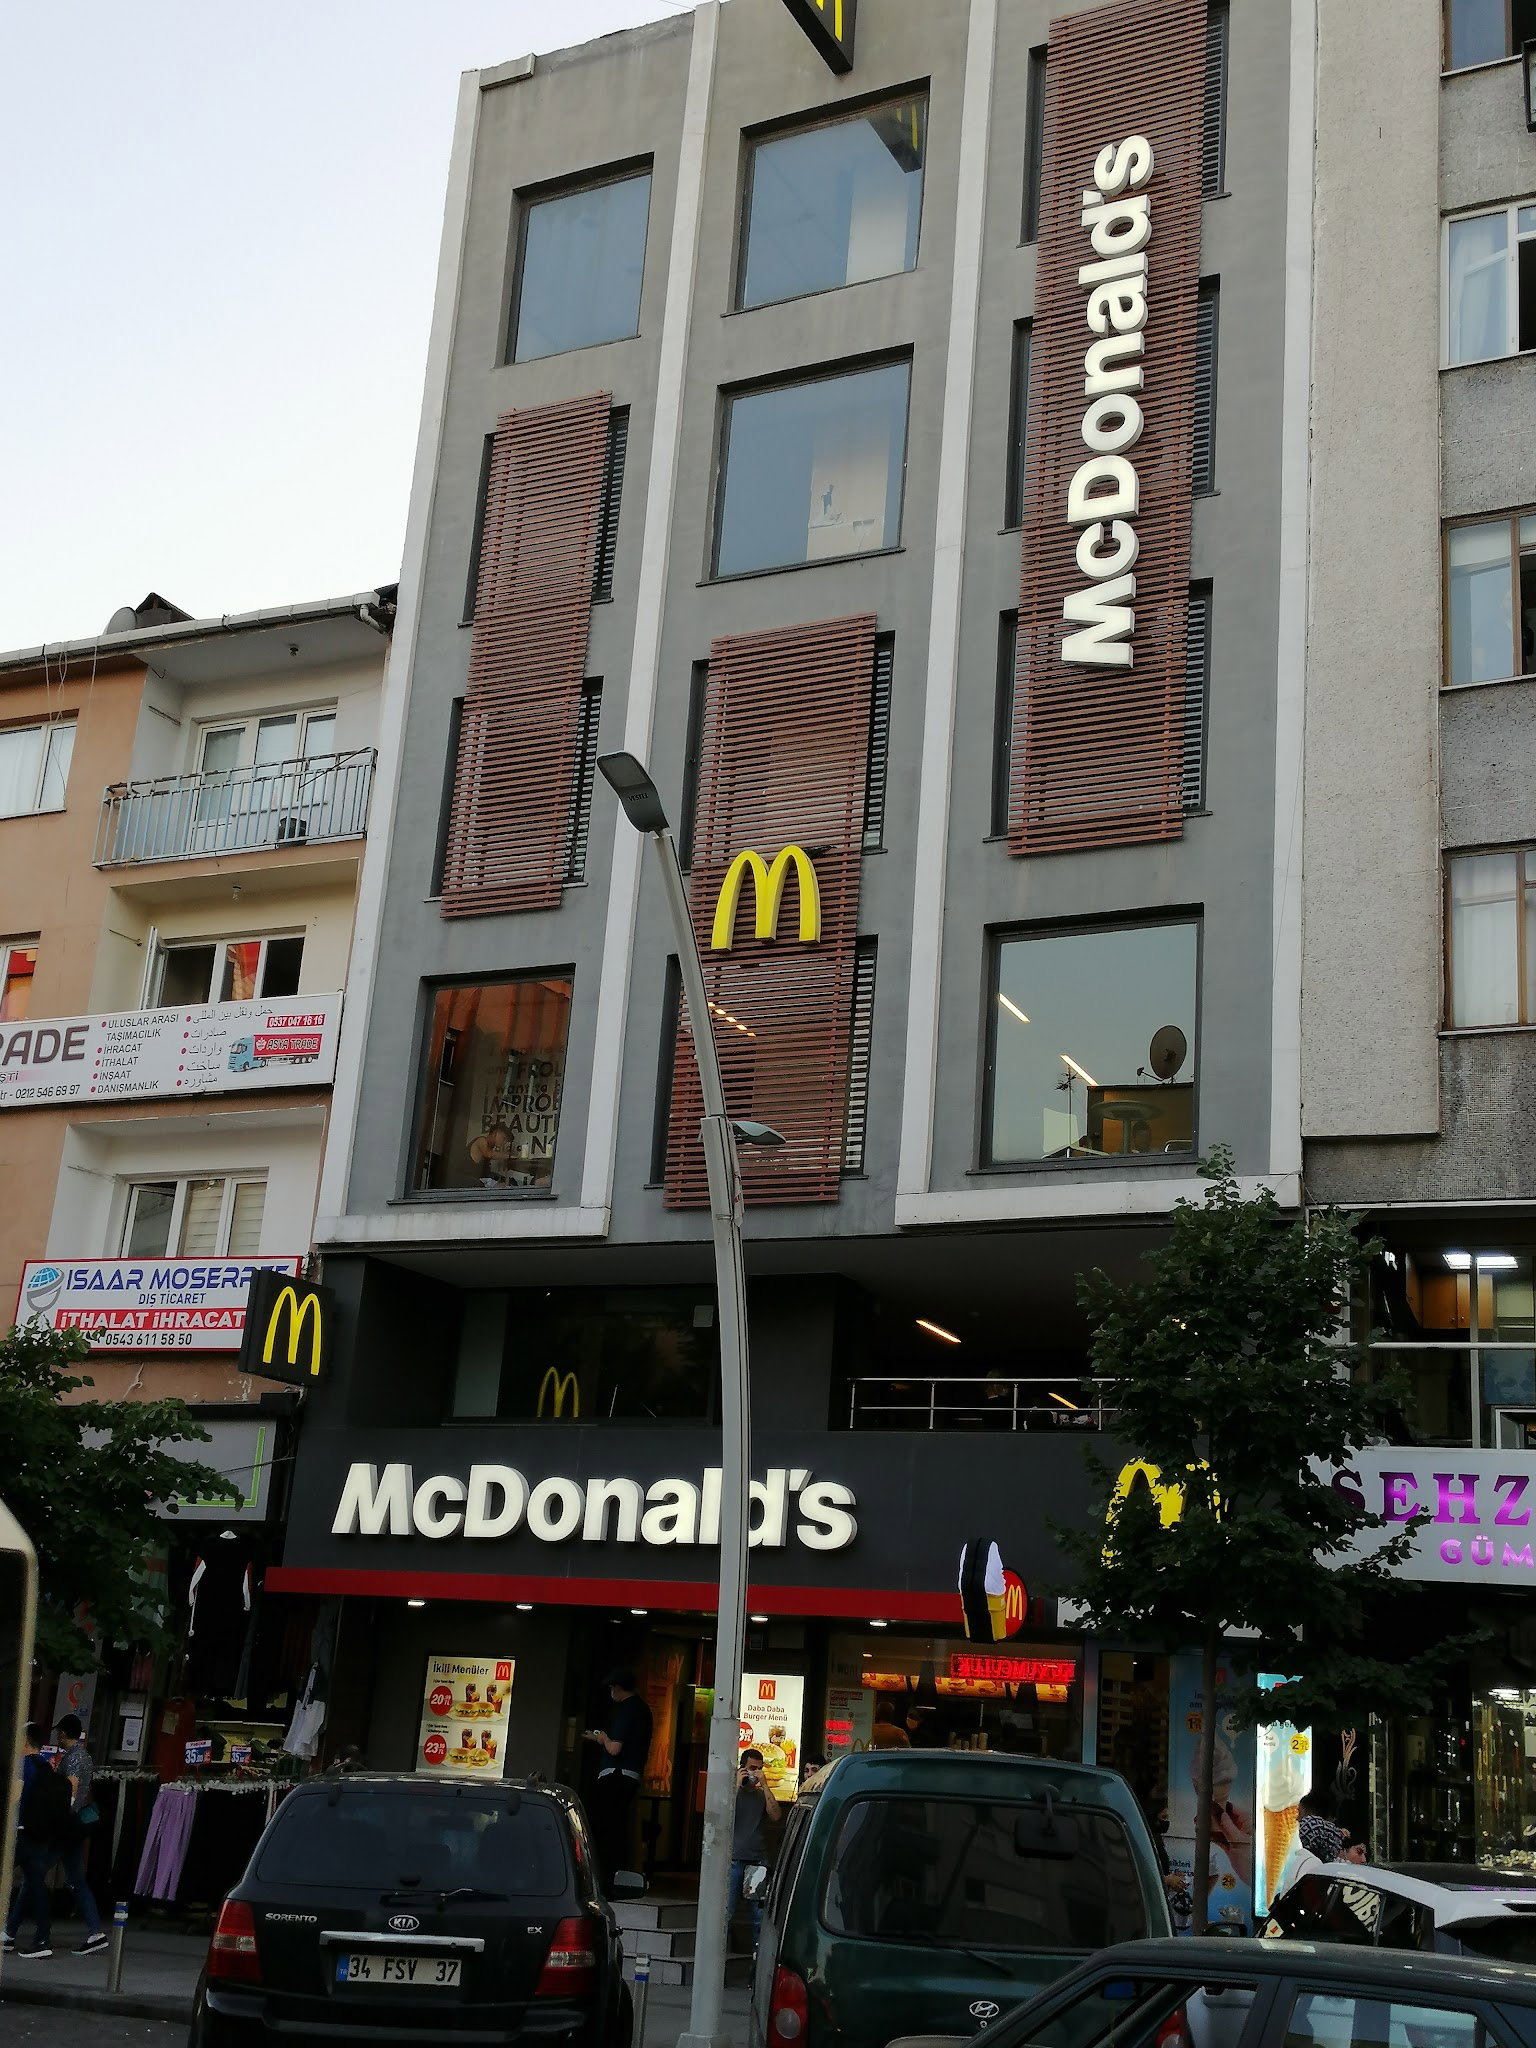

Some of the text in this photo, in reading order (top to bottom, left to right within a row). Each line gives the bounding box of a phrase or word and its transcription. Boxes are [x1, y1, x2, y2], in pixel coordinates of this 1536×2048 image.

[1061, 134, 1154, 669] McDonald's
[108, 1013, 179, 1028] ULUSLAR ARASI
[269, 1013, 324, 1027] 0537 047 16 16
[106, 1028, 162, 1042] TAŞIMACILIK
[0, 1025, 90, 1066] ADE
[103, 1043, 142, 1054] İHRACAT
[266, 1037, 319, 1050] ASYA TRADE
[101, 1057, 138, 1067] İTHALAT
[99, 1070, 132, 1082] İNŞAAT
[16, 1088, 35, 1099] 0212
[37, 1086, 54, 1097] 546
[69, 1084, 81, 1095] 97
[97, 1080, 159, 1095] DANIŞMANLIK
[66, 1268, 144, 1290] ISAAR
[138, 1290, 206, 1307] DIŞ TİCARET
[105, 1333, 193, 1346] 0543 611 58 50
[330, 1461, 858, 1551] McDonald's
[1439, 1534, 1535, 1569] GÜM
[433, 1661, 489, 1676] İkili Menüler
[747, 1704, 785, 1713] Daba Daba
[743, 1712, 788, 1722] Burger Menü
[265, 1912, 318, 1923] SORENTO
[393, 1917, 414, 1929] KIA
[527, 1926, 543, 1934] EX
[349, 1957, 371, 1979] 34
[383, 1958, 418, 1981] FSV
[435, 1960, 459, 1983] 37
